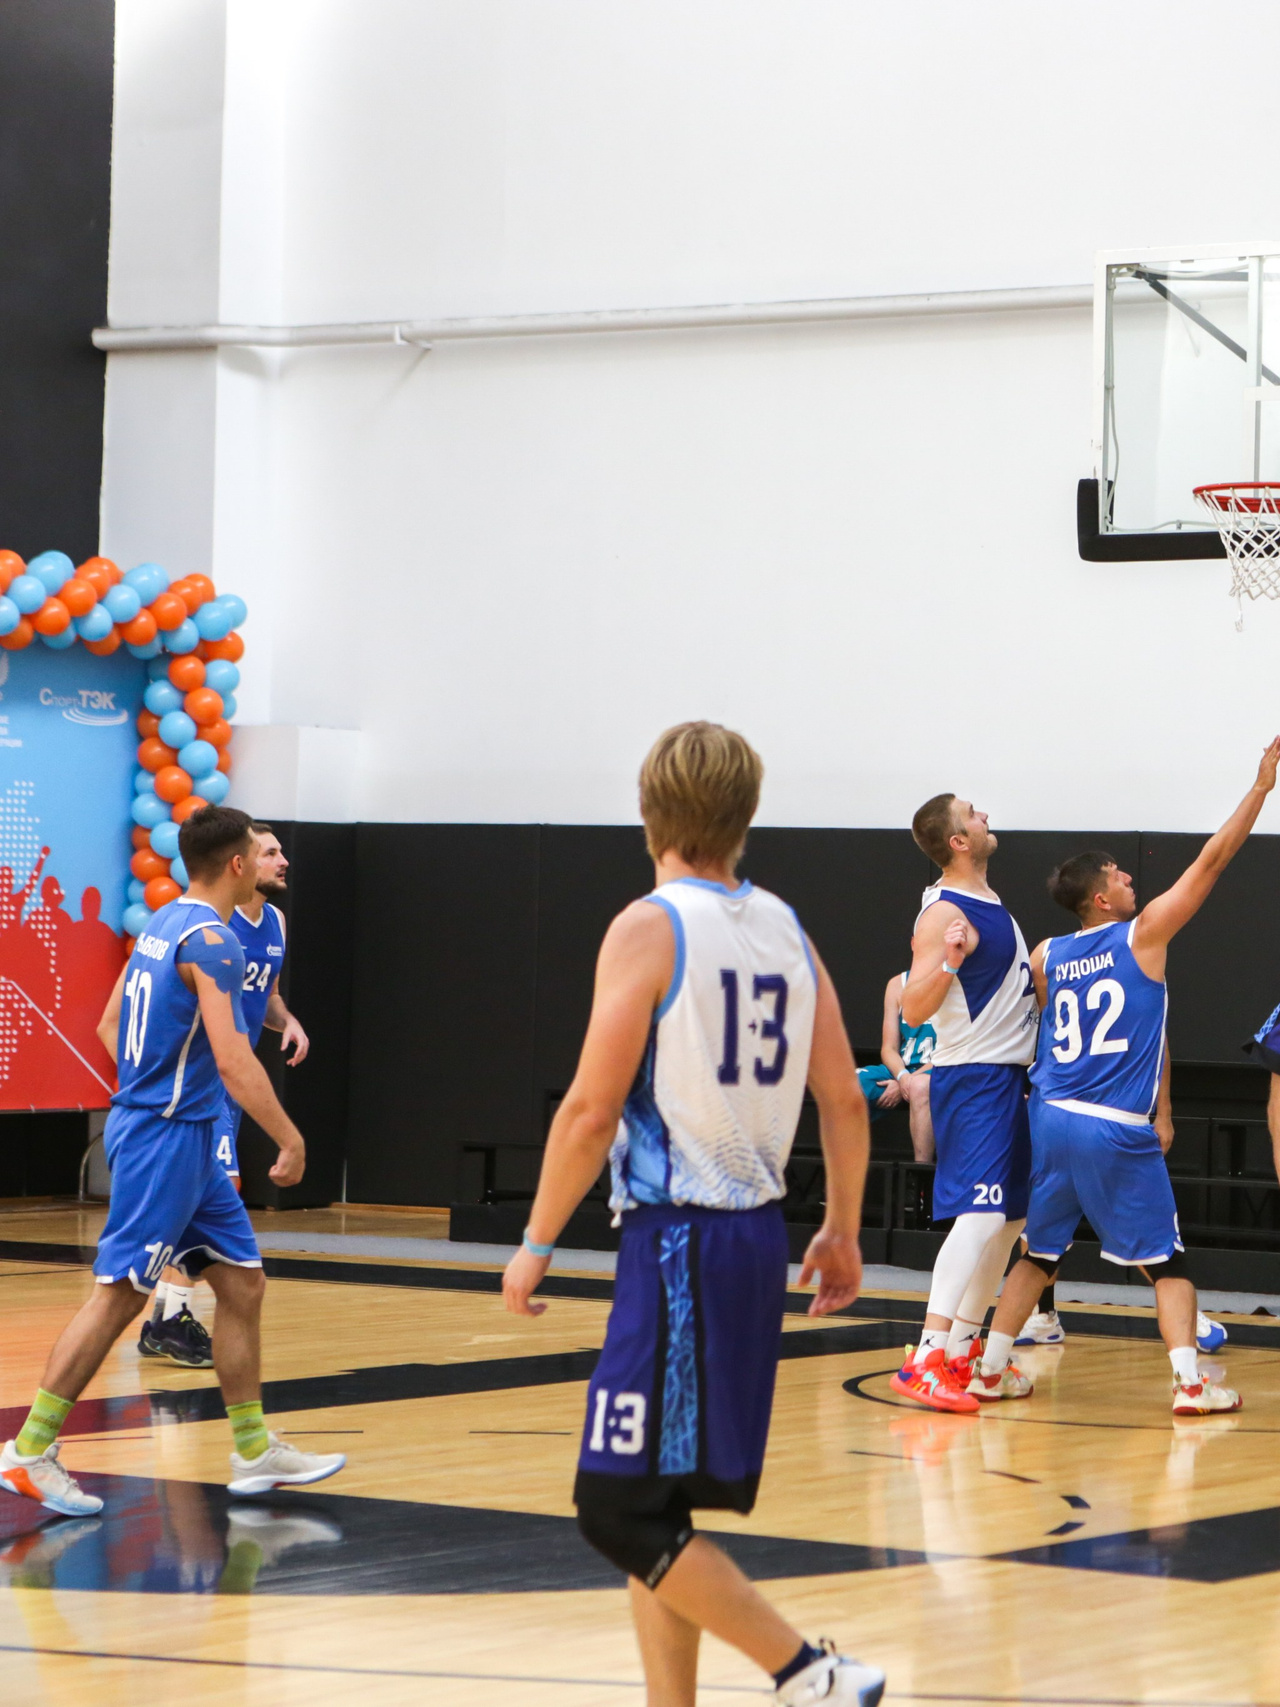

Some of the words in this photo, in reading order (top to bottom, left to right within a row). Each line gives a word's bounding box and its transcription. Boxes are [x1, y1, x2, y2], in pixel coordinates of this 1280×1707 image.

[242, 961, 272, 993] 24
[1020, 961, 1036, 998] 2
[1055, 951, 1115, 982] СУДОША
[125, 968, 152, 1068] 10
[718, 969, 788, 1085] 13
[1052, 978, 1129, 1064] 92
[216, 1135, 233, 1166] 4
[972, 1183, 1003, 1206] 20
[144, 1241, 174, 1282] 10
[589, 1388, 647, 1455] 13
